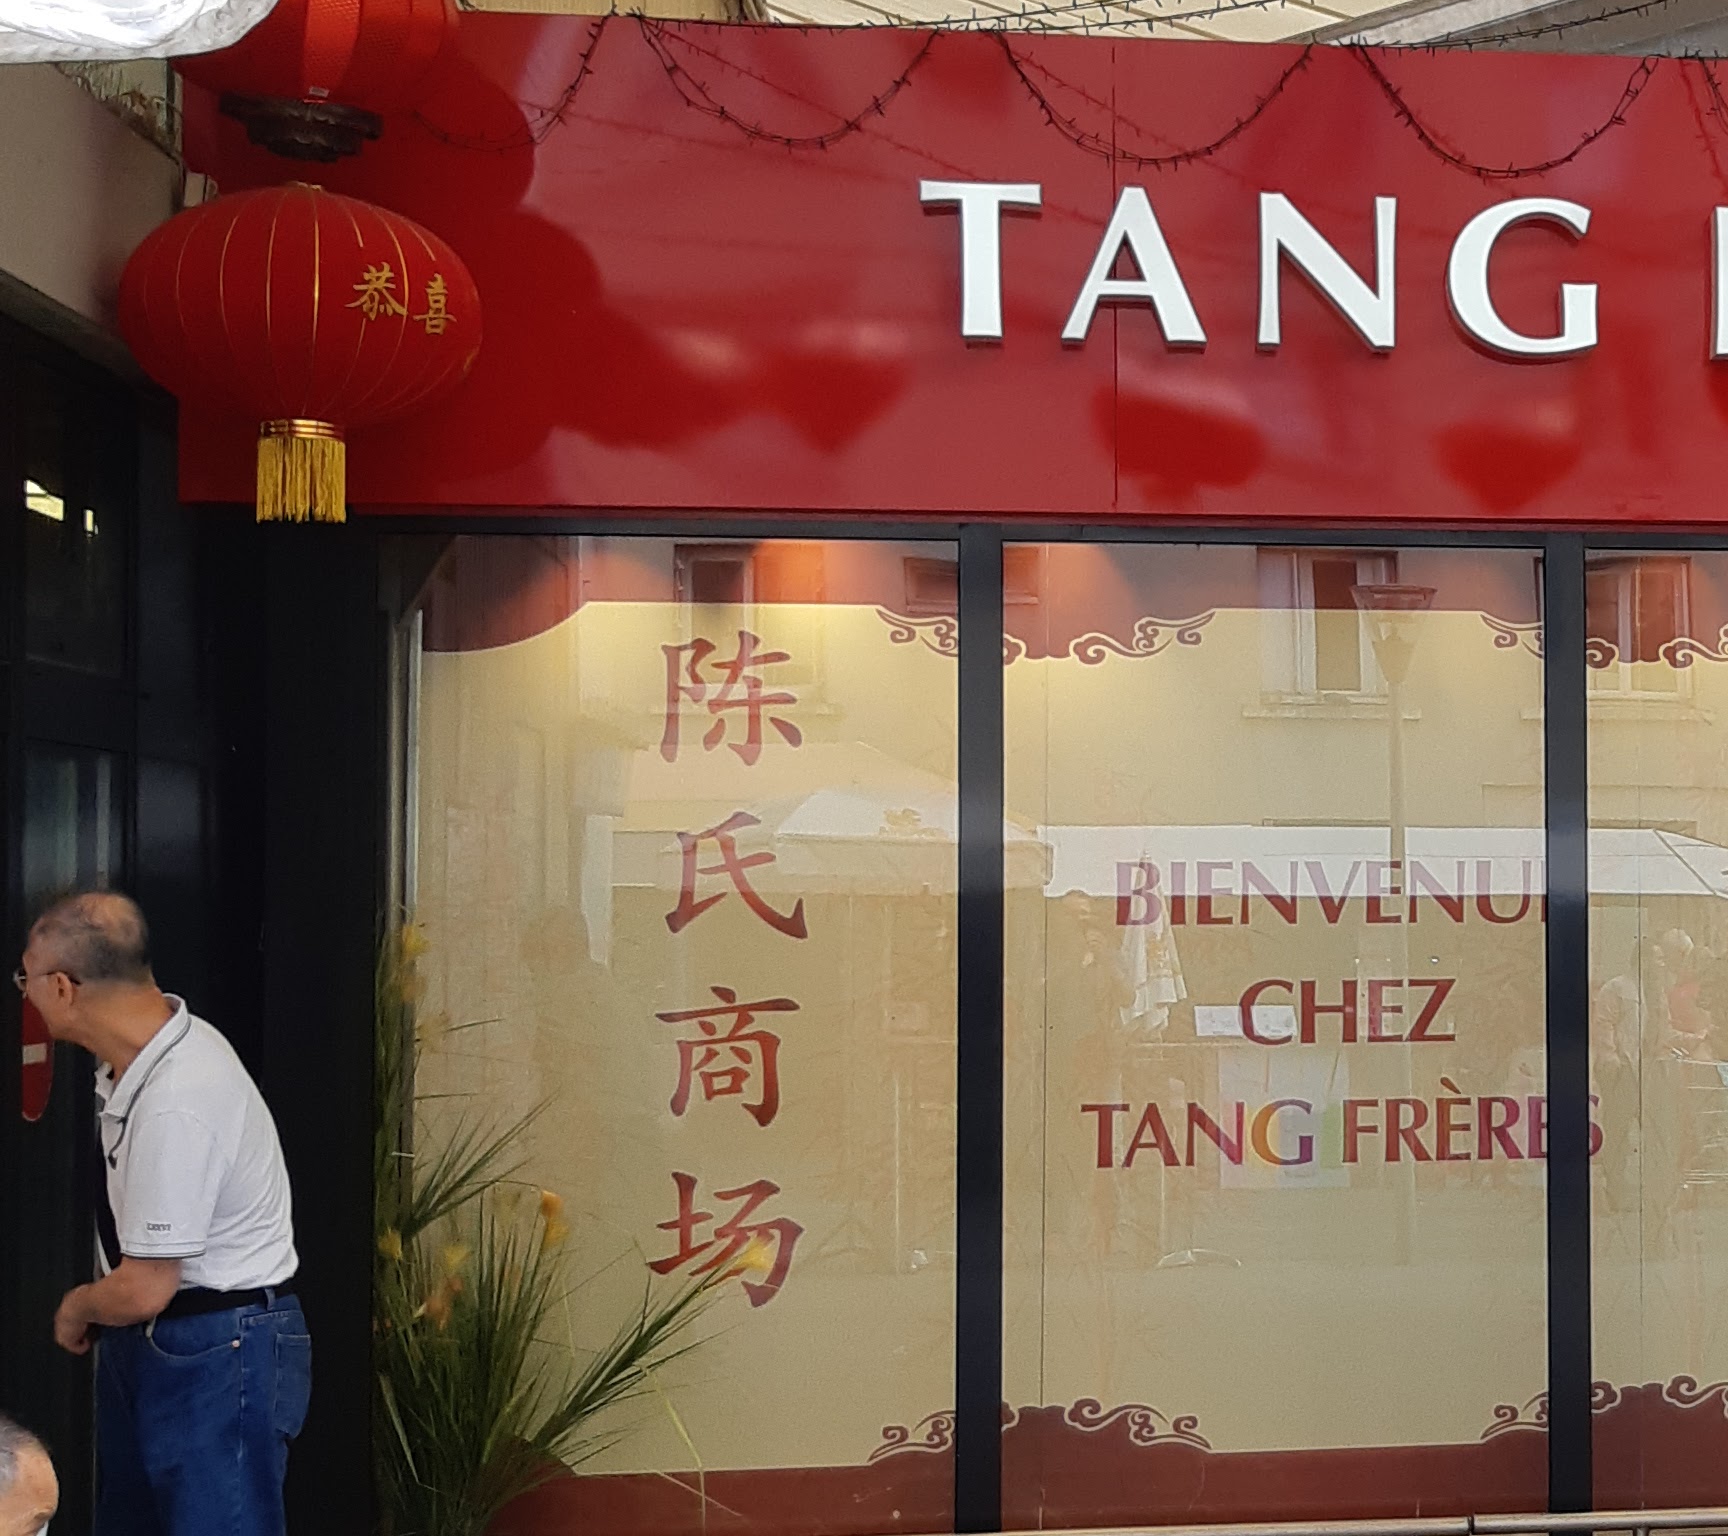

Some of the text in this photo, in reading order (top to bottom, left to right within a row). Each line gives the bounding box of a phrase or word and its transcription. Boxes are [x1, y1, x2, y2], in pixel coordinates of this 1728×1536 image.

[918, 179, 1600, 360] TANG
[1115, 860, 1547, 925] BIENVENU
[648, 629, 806, 1307] 陈氏商场
[1239, 977, 1457, 1046] CHEZ
[1080, 1098, 1315, 1169] TANG
